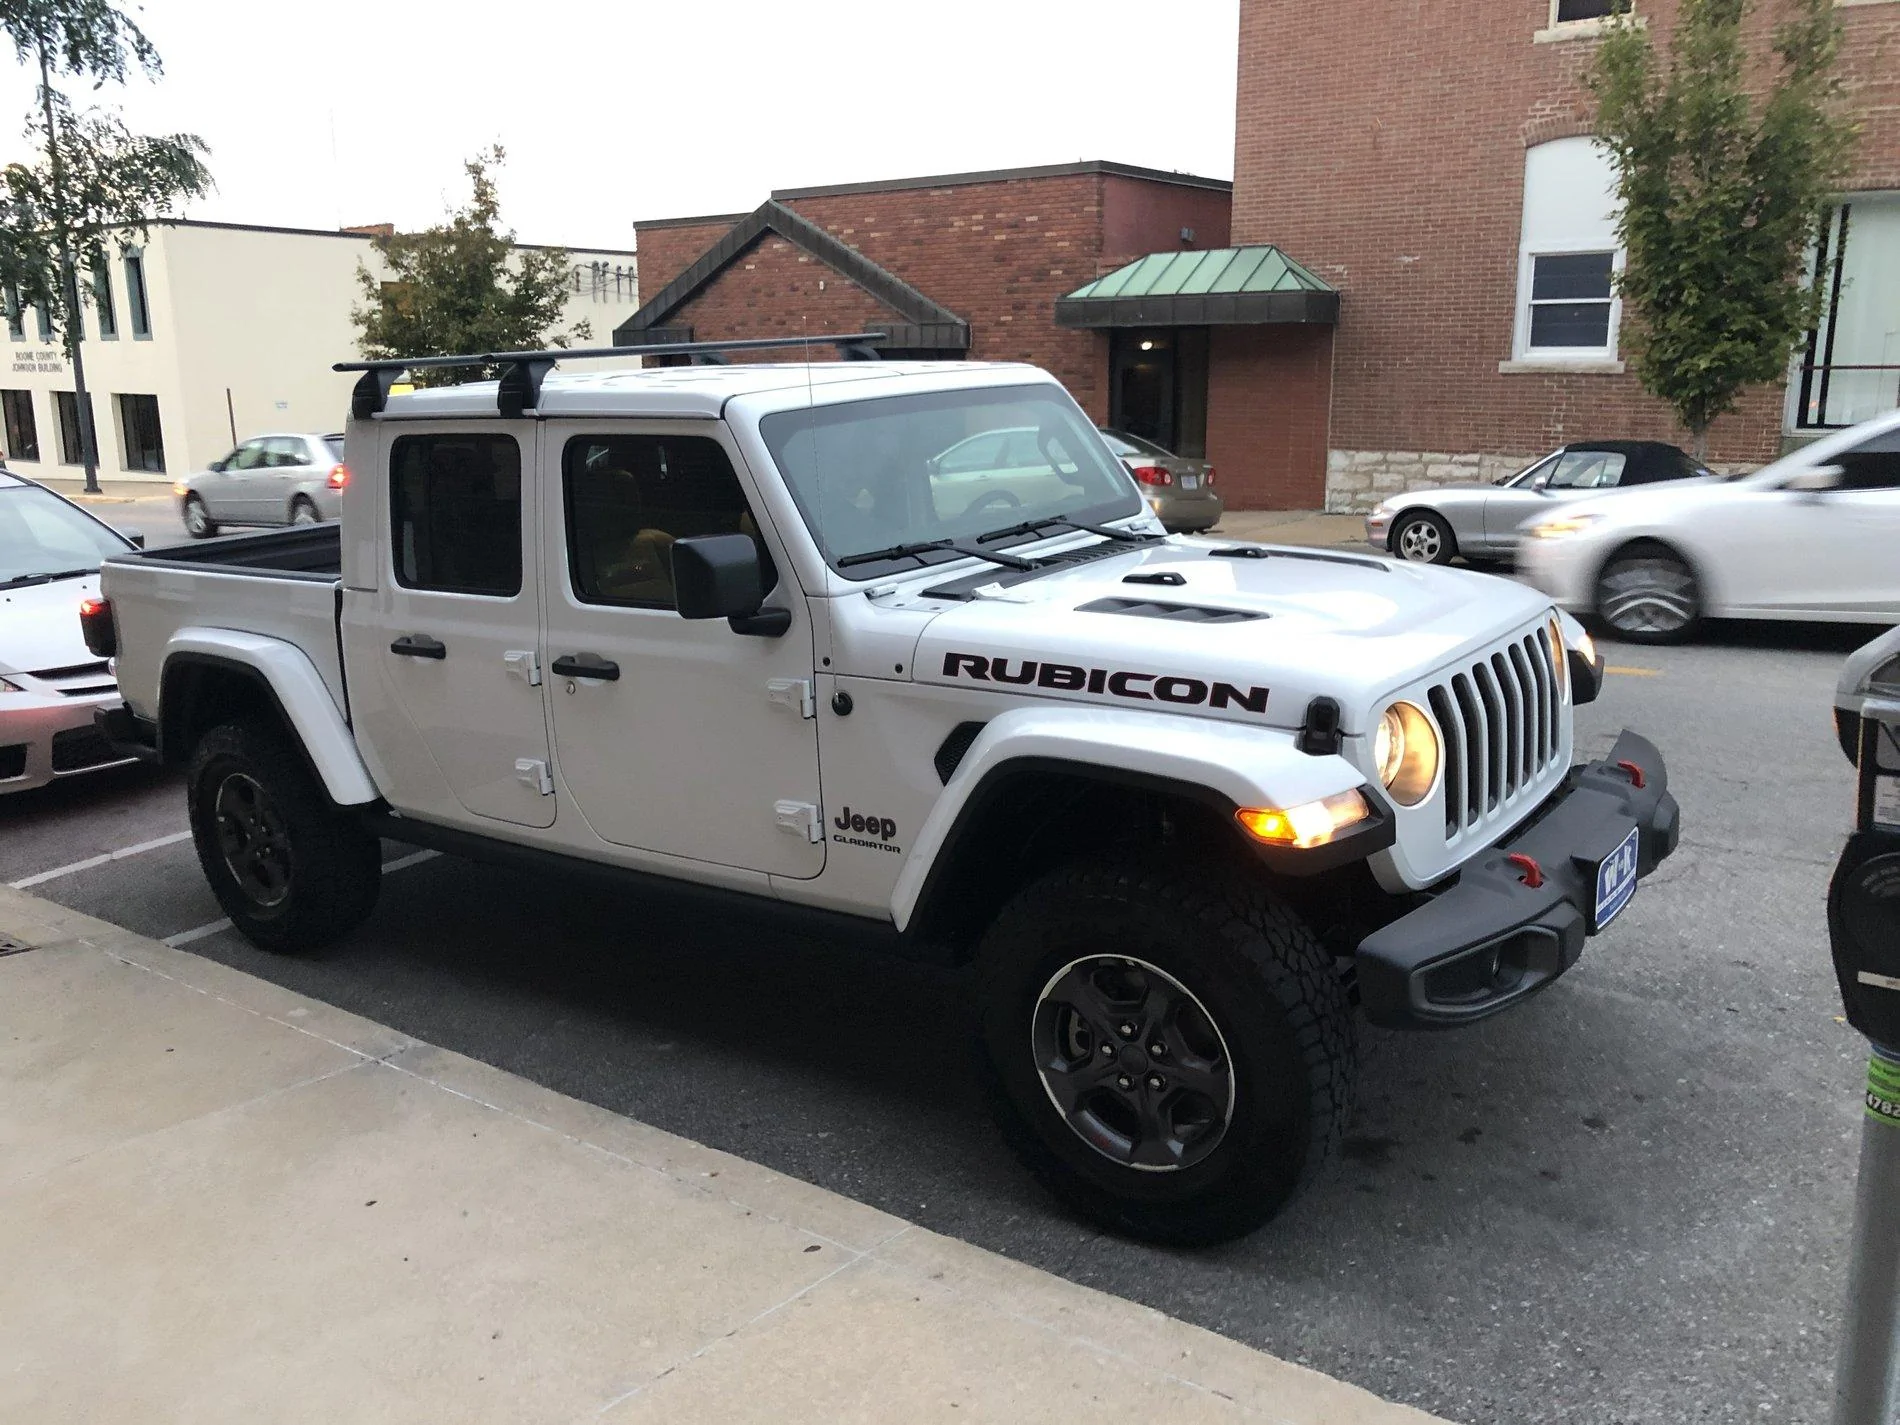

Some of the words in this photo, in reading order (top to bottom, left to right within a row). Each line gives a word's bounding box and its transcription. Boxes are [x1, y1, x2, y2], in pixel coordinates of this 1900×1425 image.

[15, 351, 34, 361] BOONE
[36, 351, 57, 360] COUNTY
[37, 363, 63, 373] BUILDING
[943, 652, 1270, 714] RUBICON
[834, 806, 897, 841] Jeep
[833, 834, 901, 854] GLADIATOR
